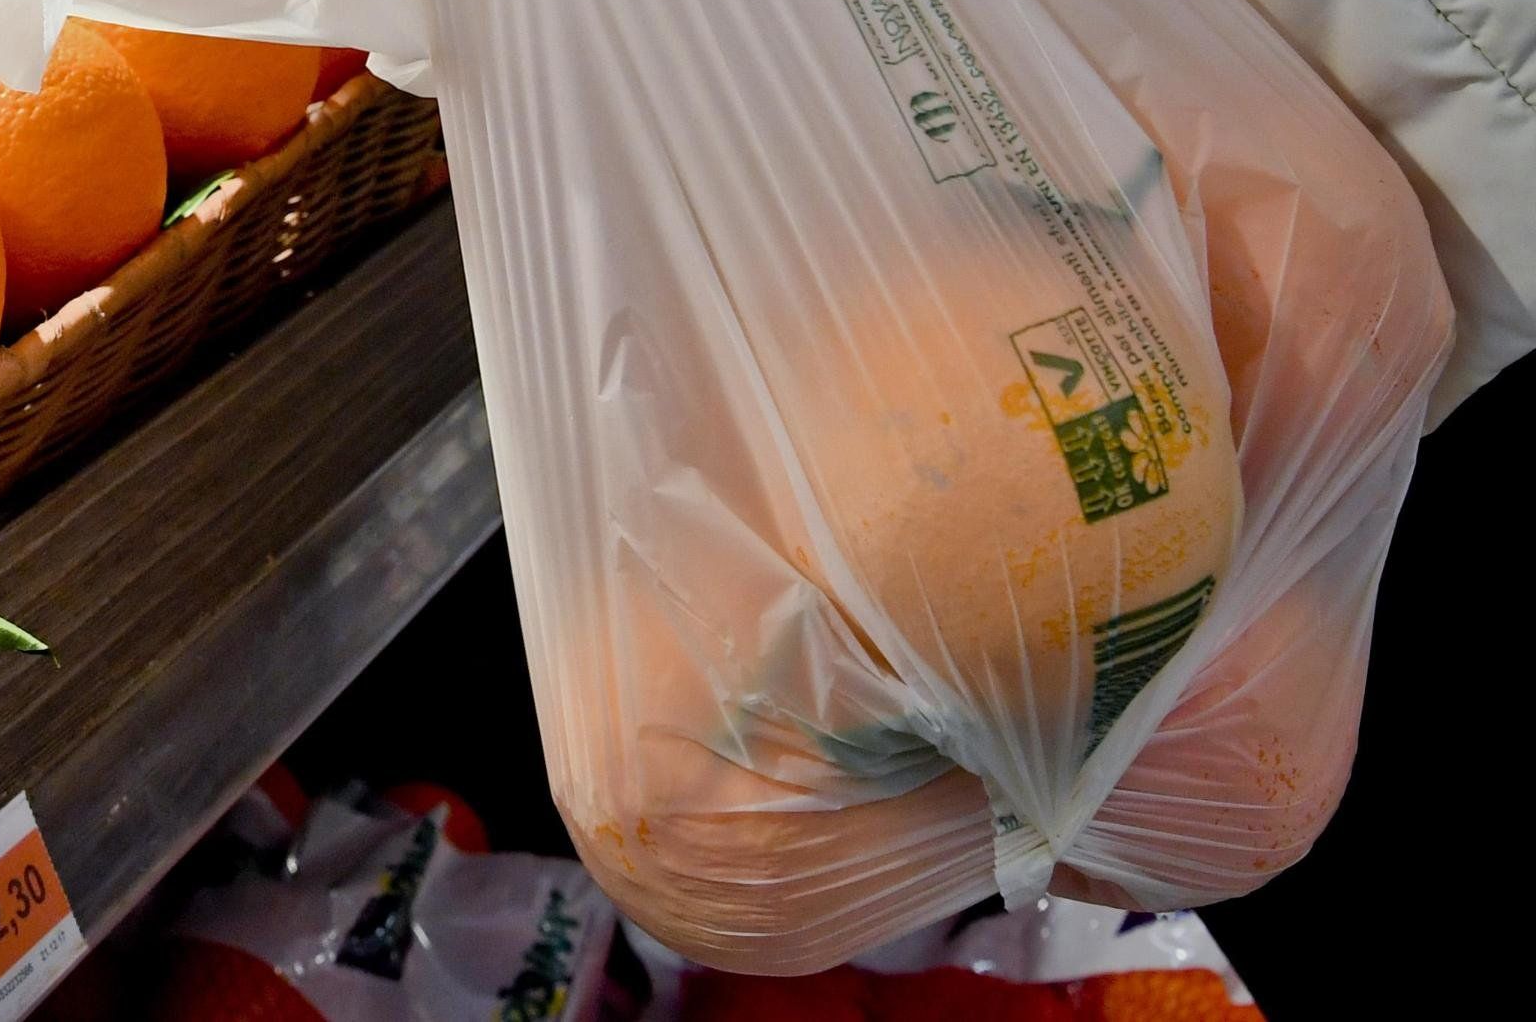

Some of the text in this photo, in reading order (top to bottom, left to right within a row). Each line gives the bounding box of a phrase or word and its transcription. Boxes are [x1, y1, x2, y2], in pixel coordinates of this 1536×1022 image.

[1060, 251, 1116, 327] alimenti
[1112, 335, 1142, 367] per
[1135, 369, 1174, 436] Borsa
